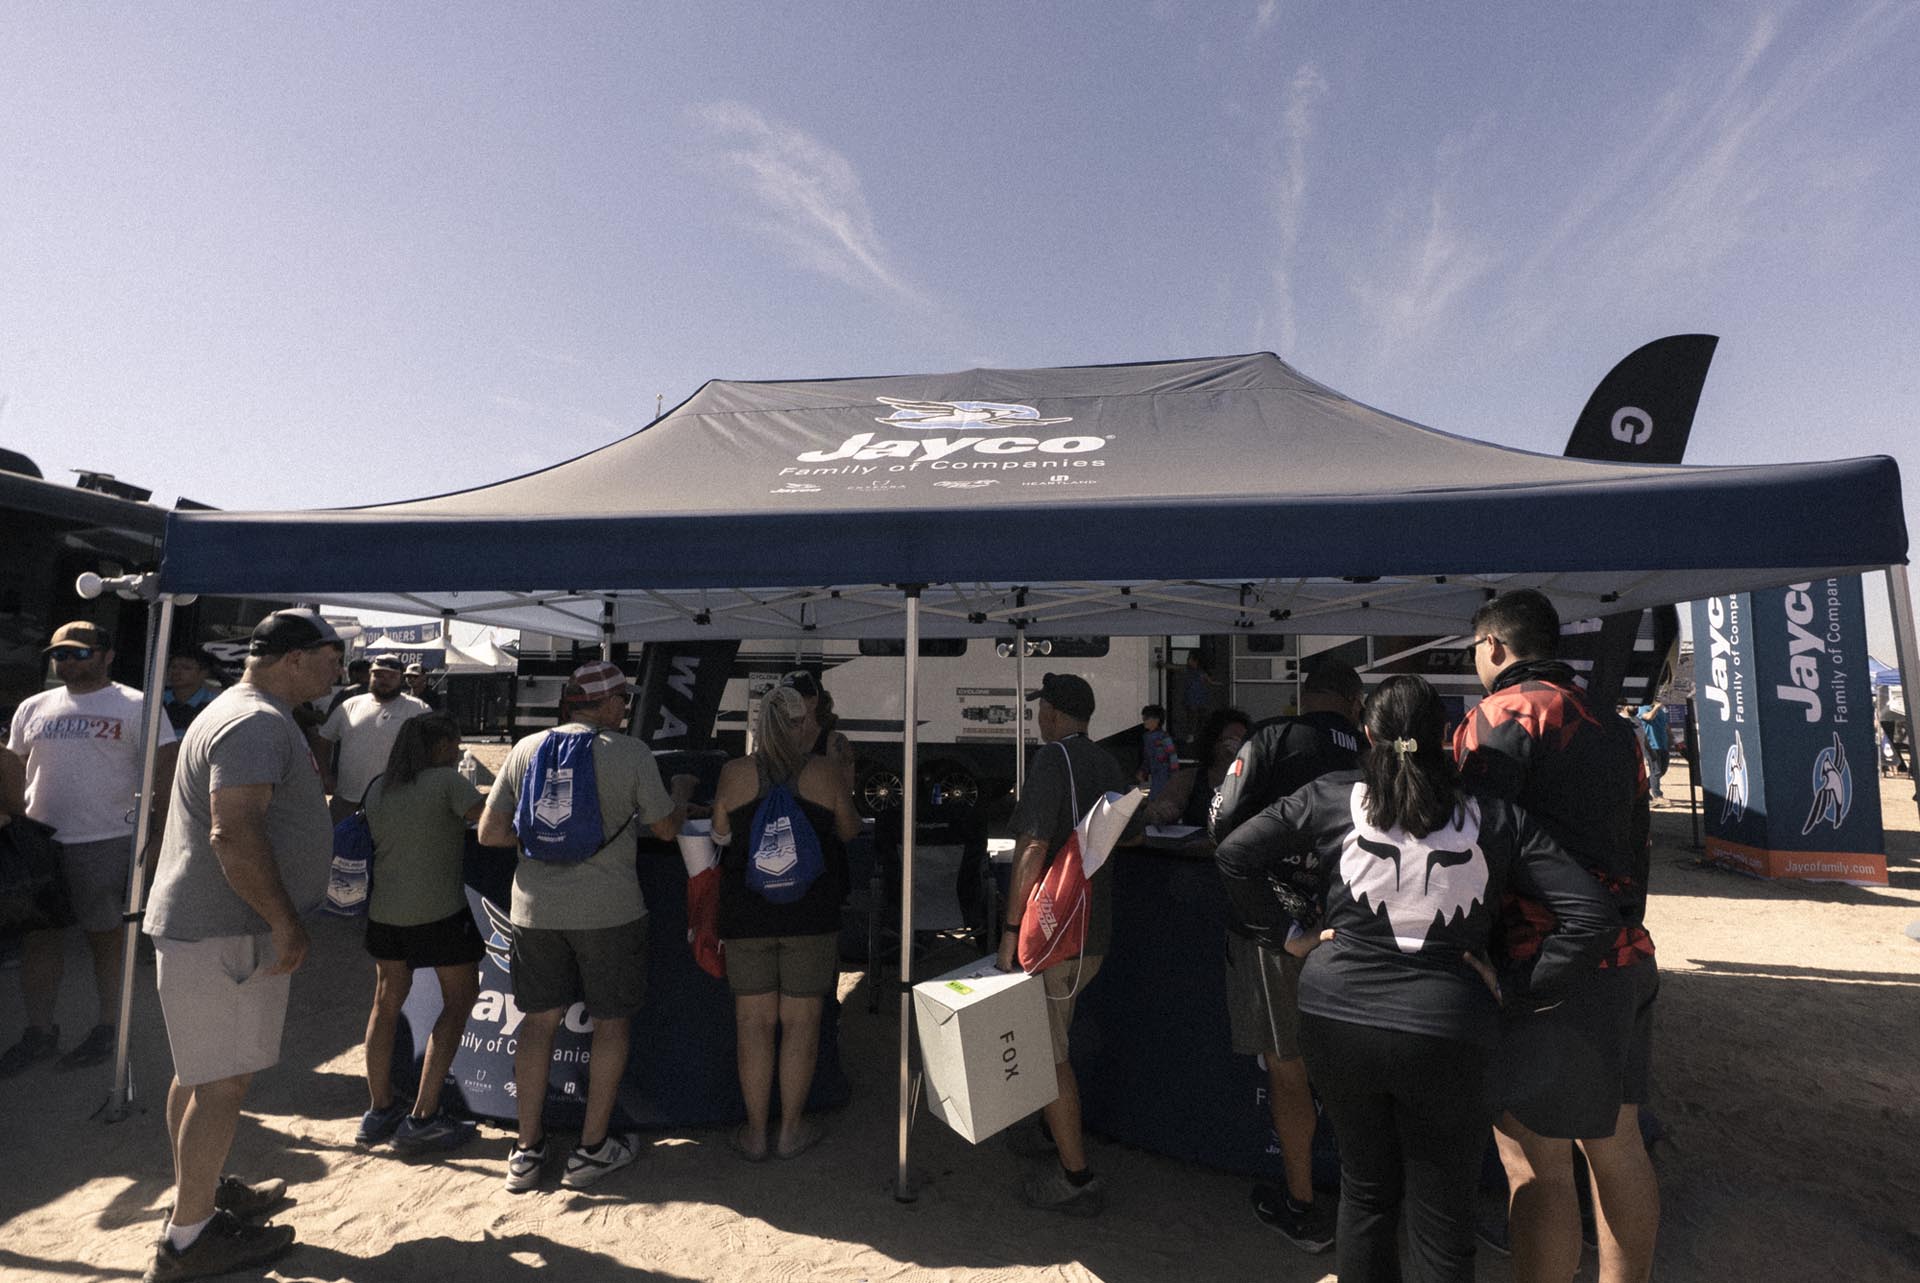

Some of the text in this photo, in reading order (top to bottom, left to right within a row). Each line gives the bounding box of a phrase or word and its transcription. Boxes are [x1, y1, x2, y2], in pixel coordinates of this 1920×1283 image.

[1611, 406, 1653, 445] G
[797, 432, 1106, 462] Jayco
[778, 459, 1106, 476] Family of Companies
[394, 652, 424, 664] TORE
[1730, 649, 1740, 666] of
[1828, 648, 1843, 664] of
[1733, 671, 1745, 723] Family
[1831, 670, 1848, 723] Family
[1786, 860, 1875, 875] Jaycofamily.com
[486, 1037, 502, 1053] of
[1000, 1030, 1019, 1081] FOX
